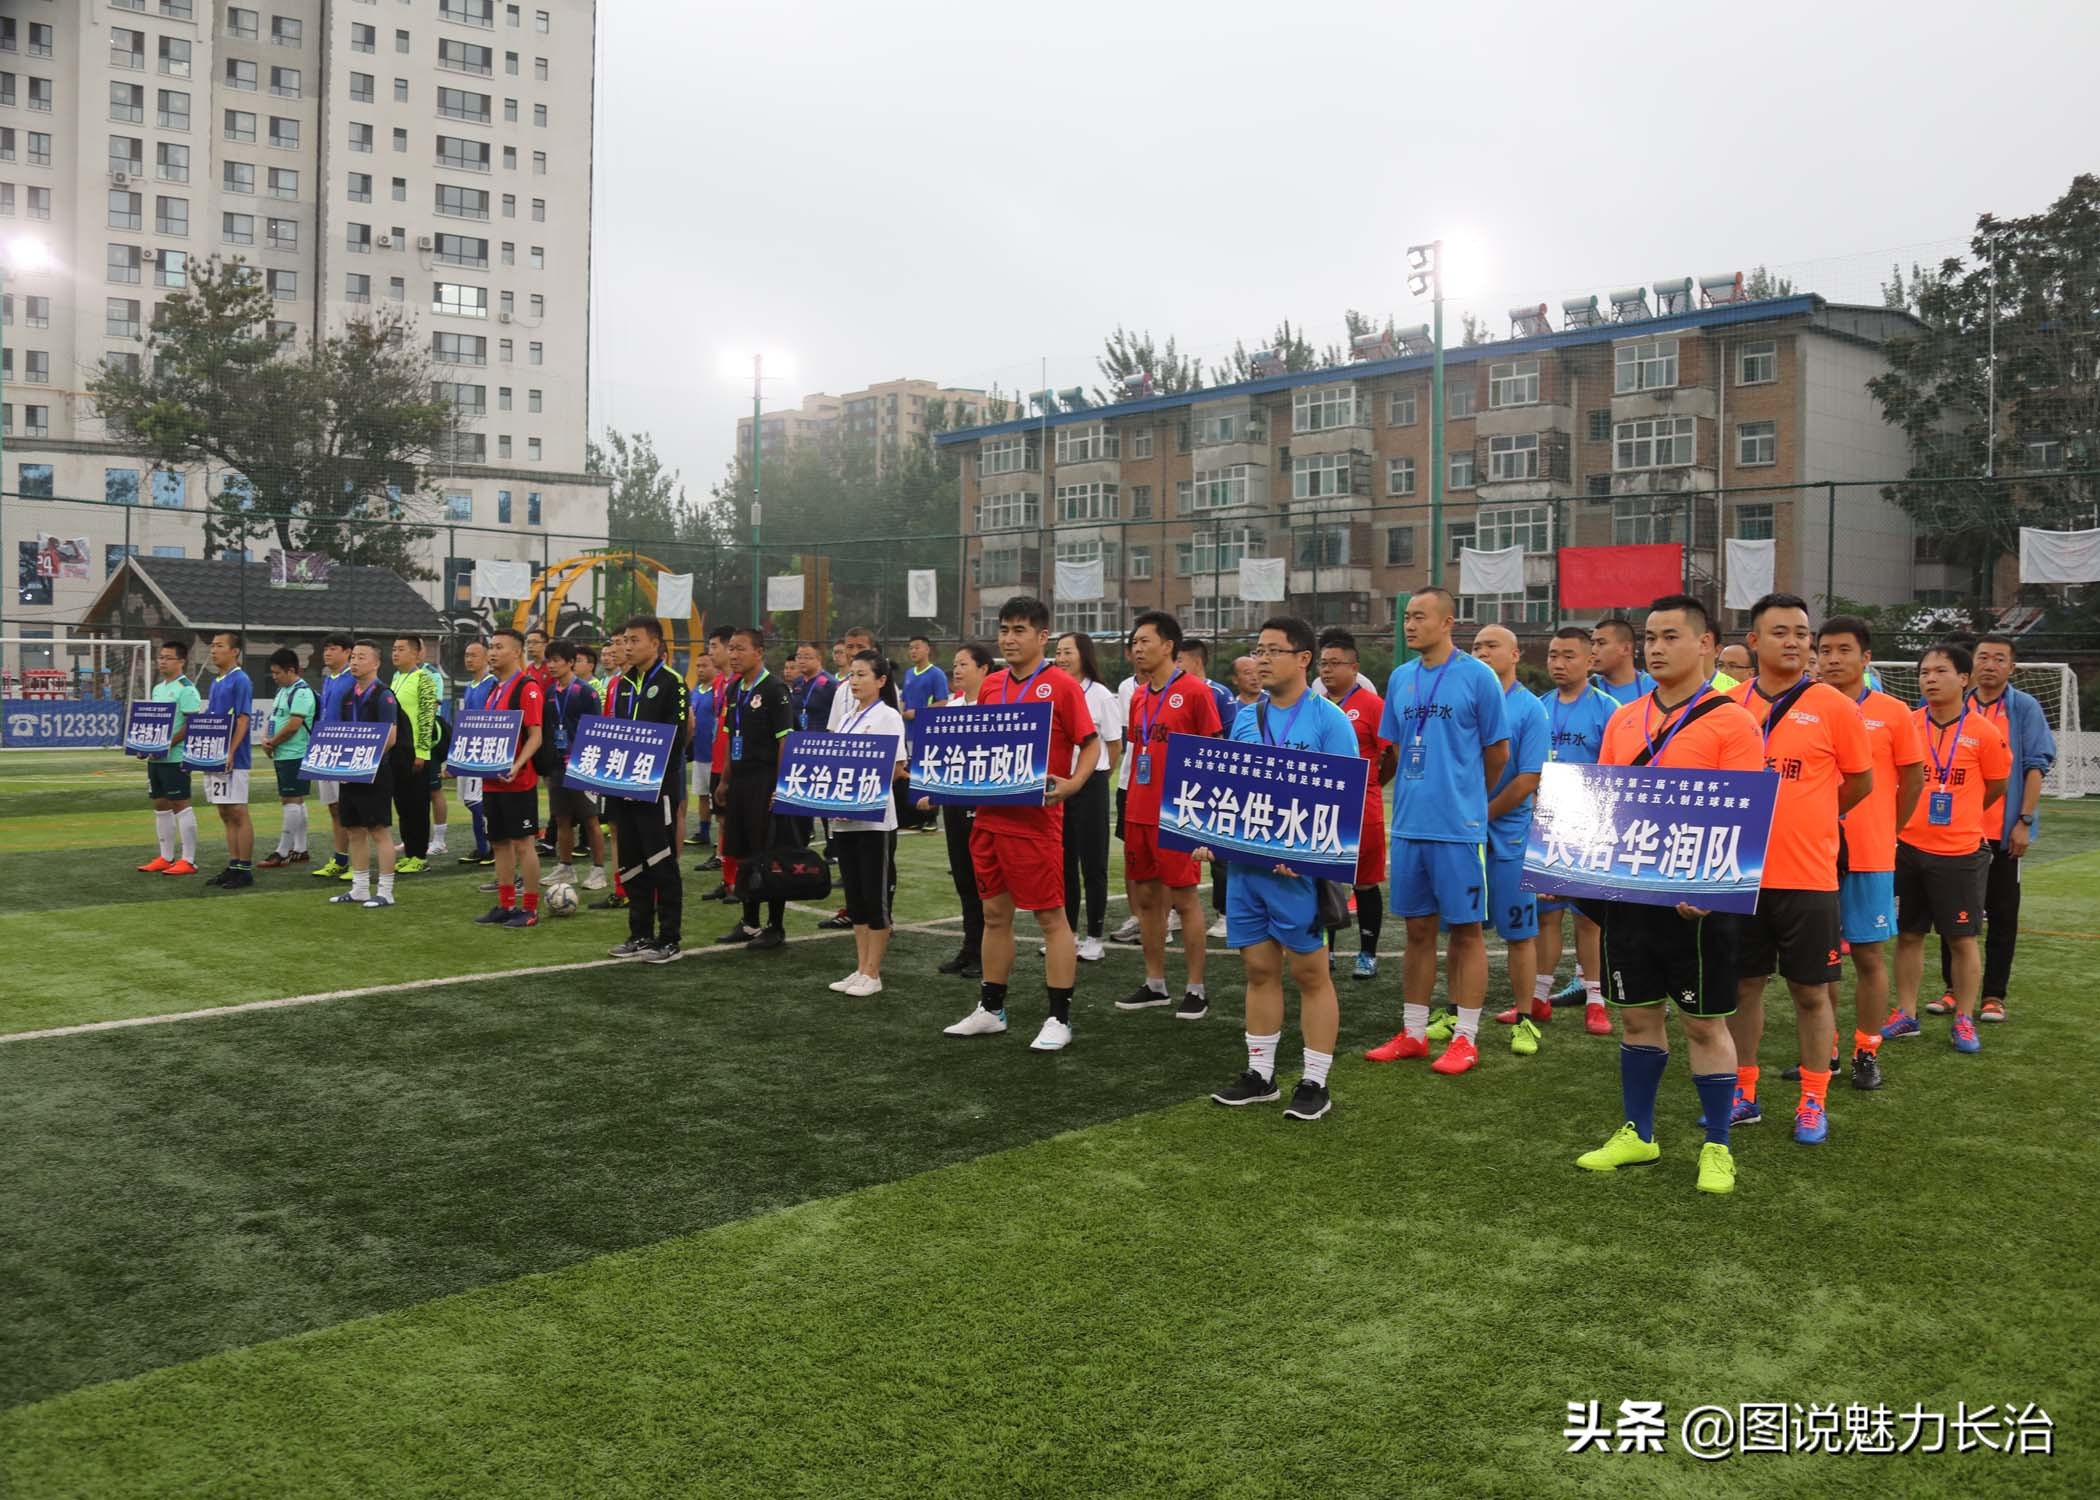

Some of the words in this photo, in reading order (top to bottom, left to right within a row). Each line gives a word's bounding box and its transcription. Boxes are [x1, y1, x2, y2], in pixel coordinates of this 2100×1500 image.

[41, 713, 119, 737] 5123333
[307, 743, 376, 769] 省设计二院队
[453, 736, 510, 763] 机关联队
[578, 745, 655, 784] 裁判组
[919, 743, 1037, 785] 长治市政队
[214, 782, 227, 796] 21
[785, 763, 882, 804] 长治足协
[1173, 780, 1344, 857] 长治供水队
[1467, 886, 1480, 911] 7
[1509, 903, 1535, 928] 27
